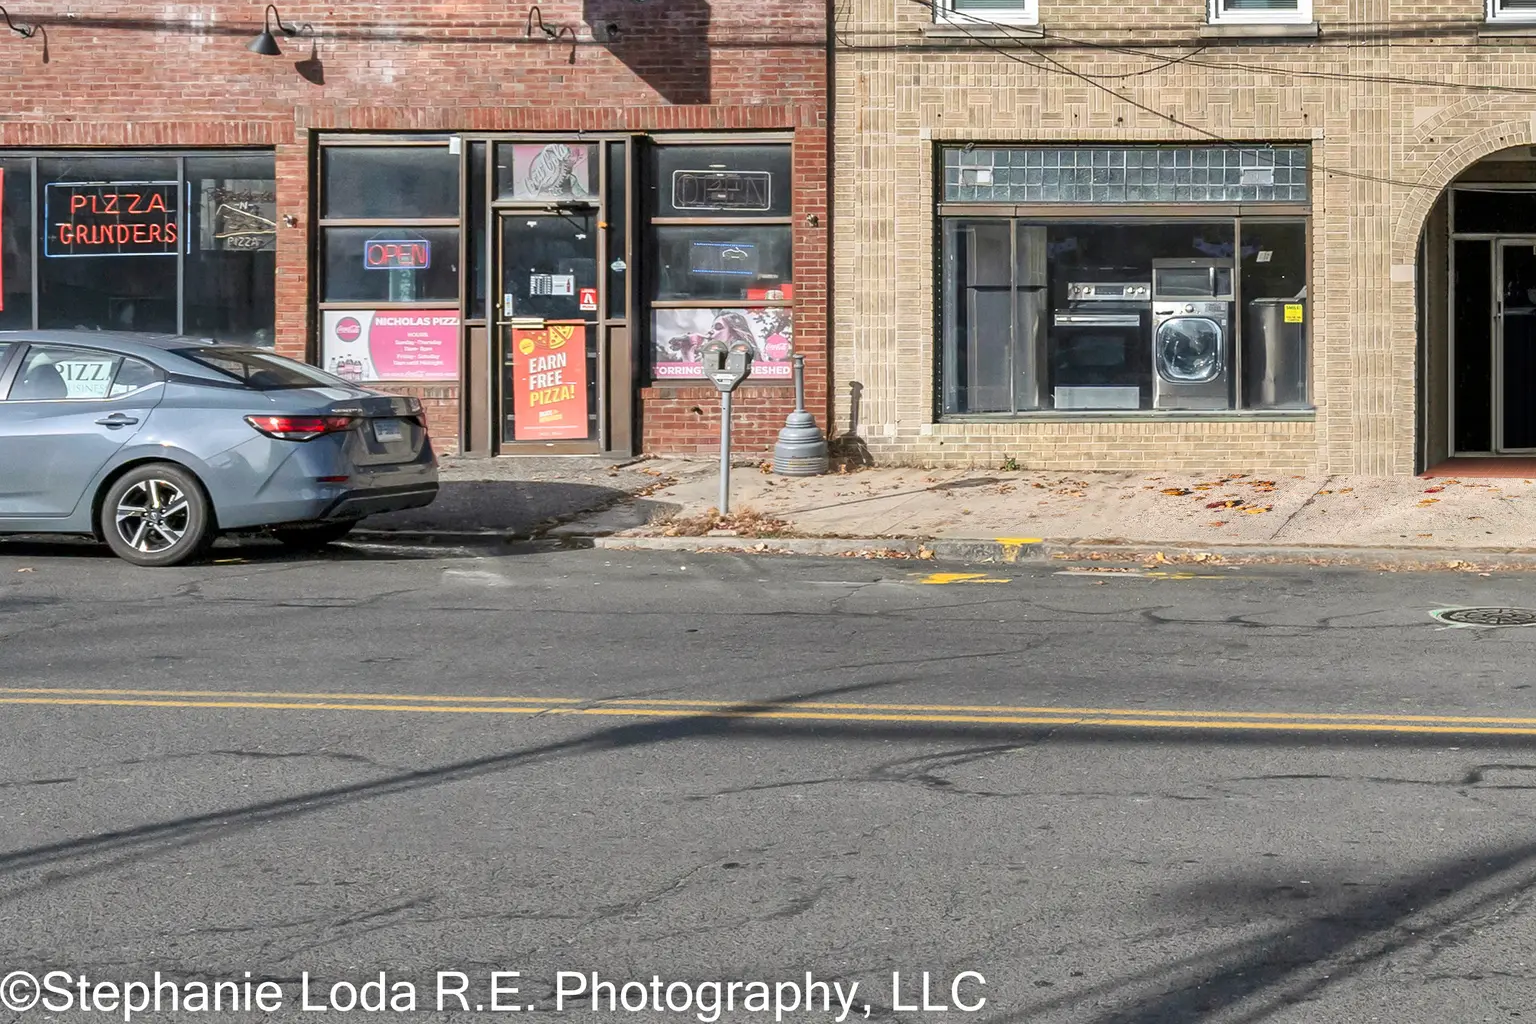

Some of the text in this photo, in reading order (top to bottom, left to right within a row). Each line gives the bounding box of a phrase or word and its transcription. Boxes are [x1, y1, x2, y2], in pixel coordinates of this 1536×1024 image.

[70, 194, 166, 214] PIZZA
[59, 223, 177, 244] GRINDERS
[227, 236, 259, 247] PIZZA
[367, 244, 426, 265] OPEN
[375, 317, 431, 326] NICHOLAS
[57, 364, 110, 381] PIZZ
[528, 352, 567, 374] EARN
[653, 366, 705, 375] TORRING
[529, 370, 563, 390] FREE
[529, 384, 575, 407] PIZZA!
